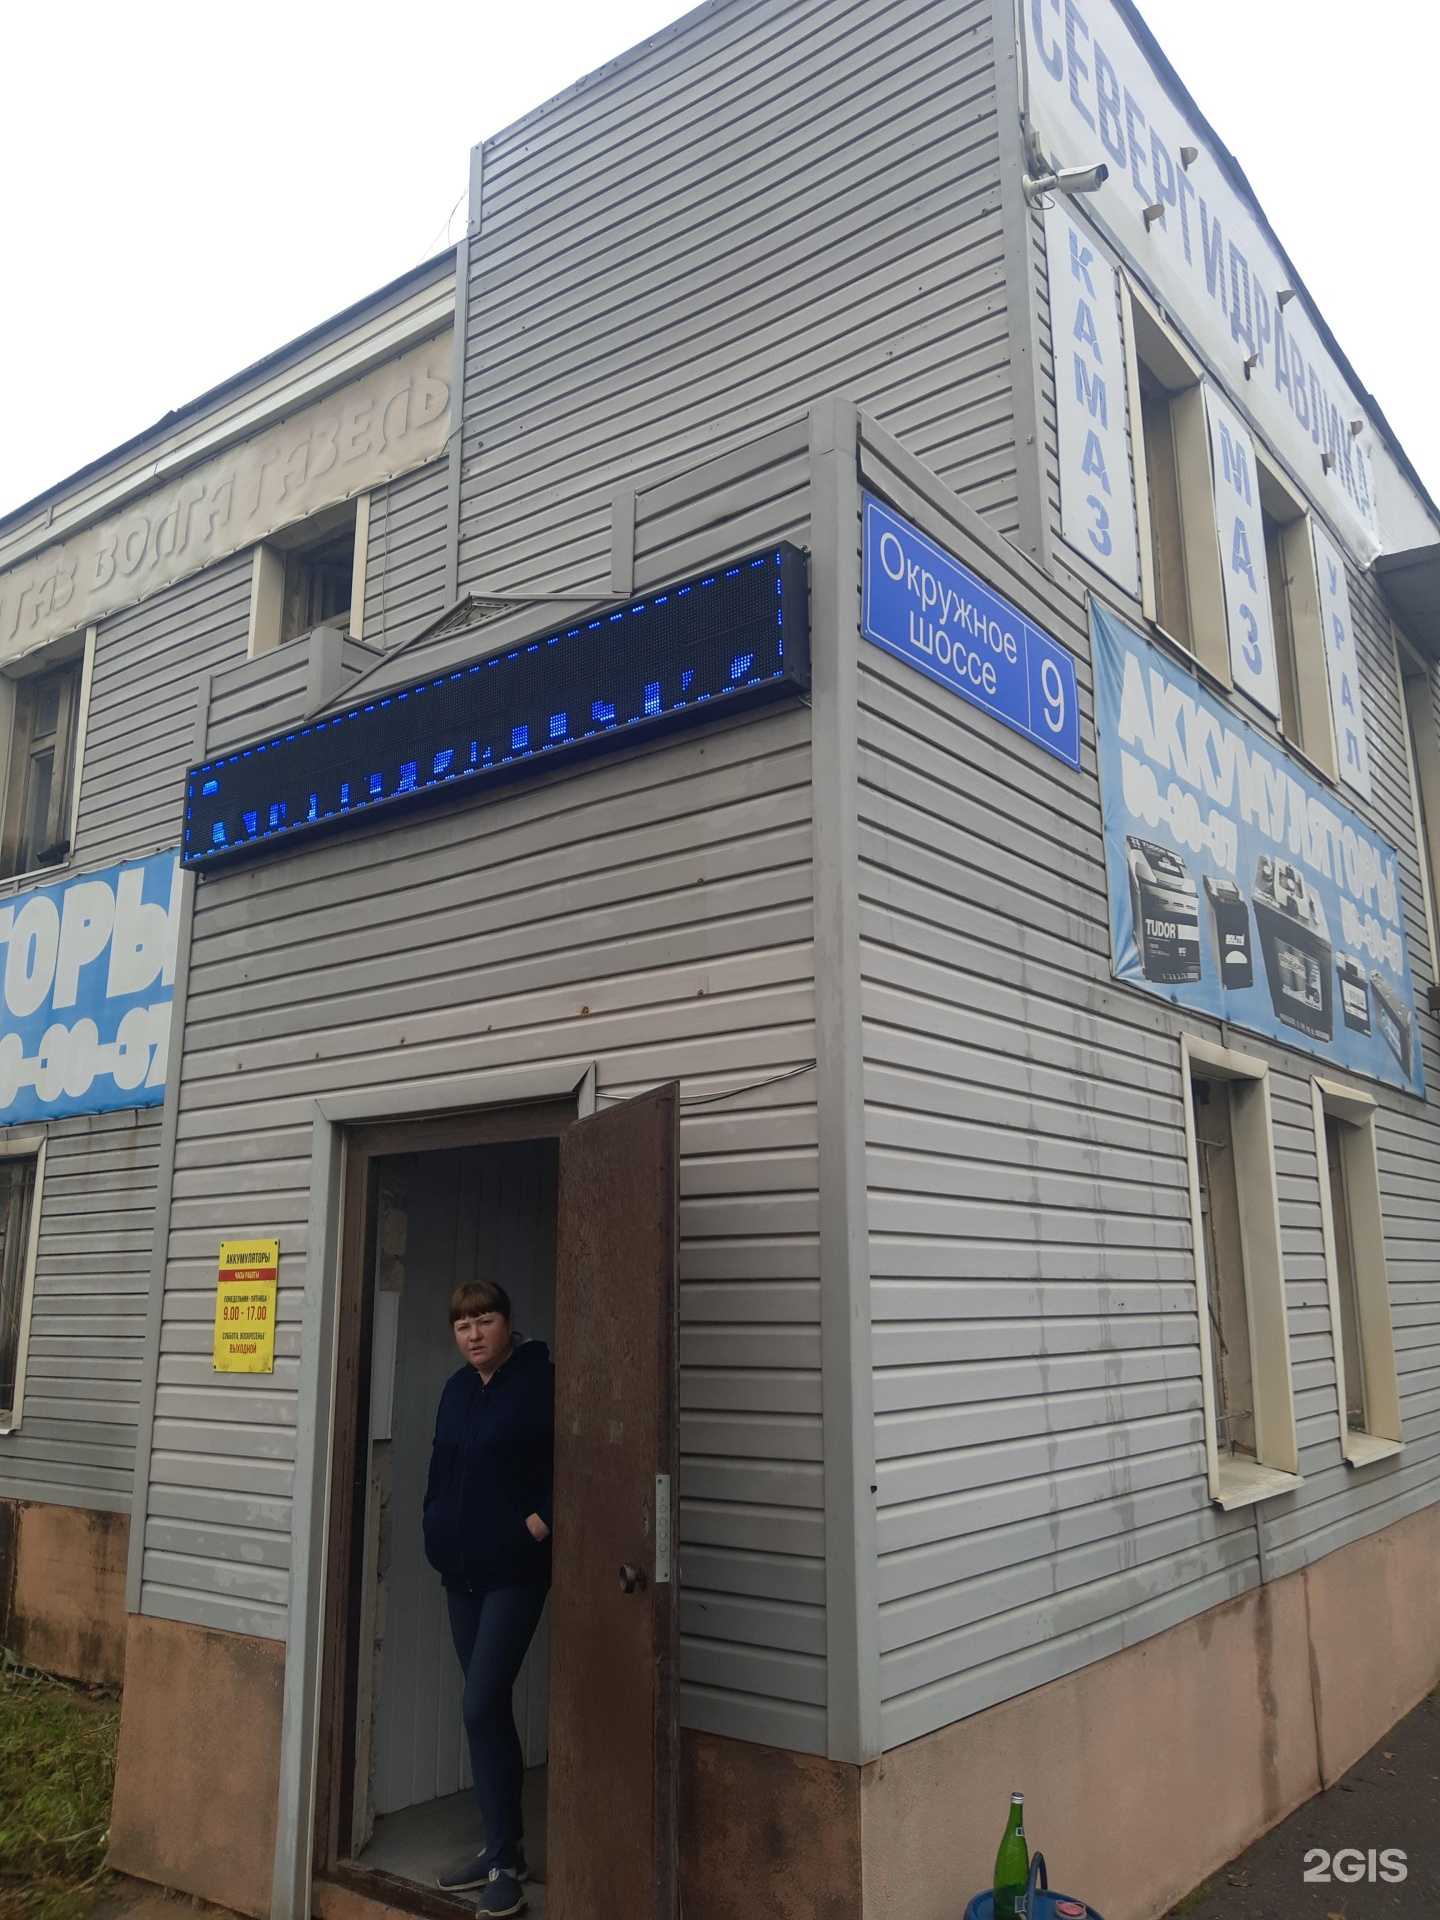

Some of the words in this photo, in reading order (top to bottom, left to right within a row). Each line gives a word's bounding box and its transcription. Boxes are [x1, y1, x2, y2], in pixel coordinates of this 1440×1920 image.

[1069, 226, 1112, 557] КАМАЗ
[880, 532, 1017, 664] Окружное
[1218, 419, 1262, 676] МАЗ
[910, 610, 997, 695] шоссе
[1041, 658, 1065, 733] 9
[1326, 556, 1361, 770] УРАЛ
[1120, 650, 1399, 925] АККУМУЛЯТОРЫ
[1145, 918, 1177, 939] TUDOR
[226, 1252, 271, 1264] АККУМУЛЯТОРЫ
[223, 1306, 240, 1321] 9.00
[247, 1305, 267, 1321] 17.00
